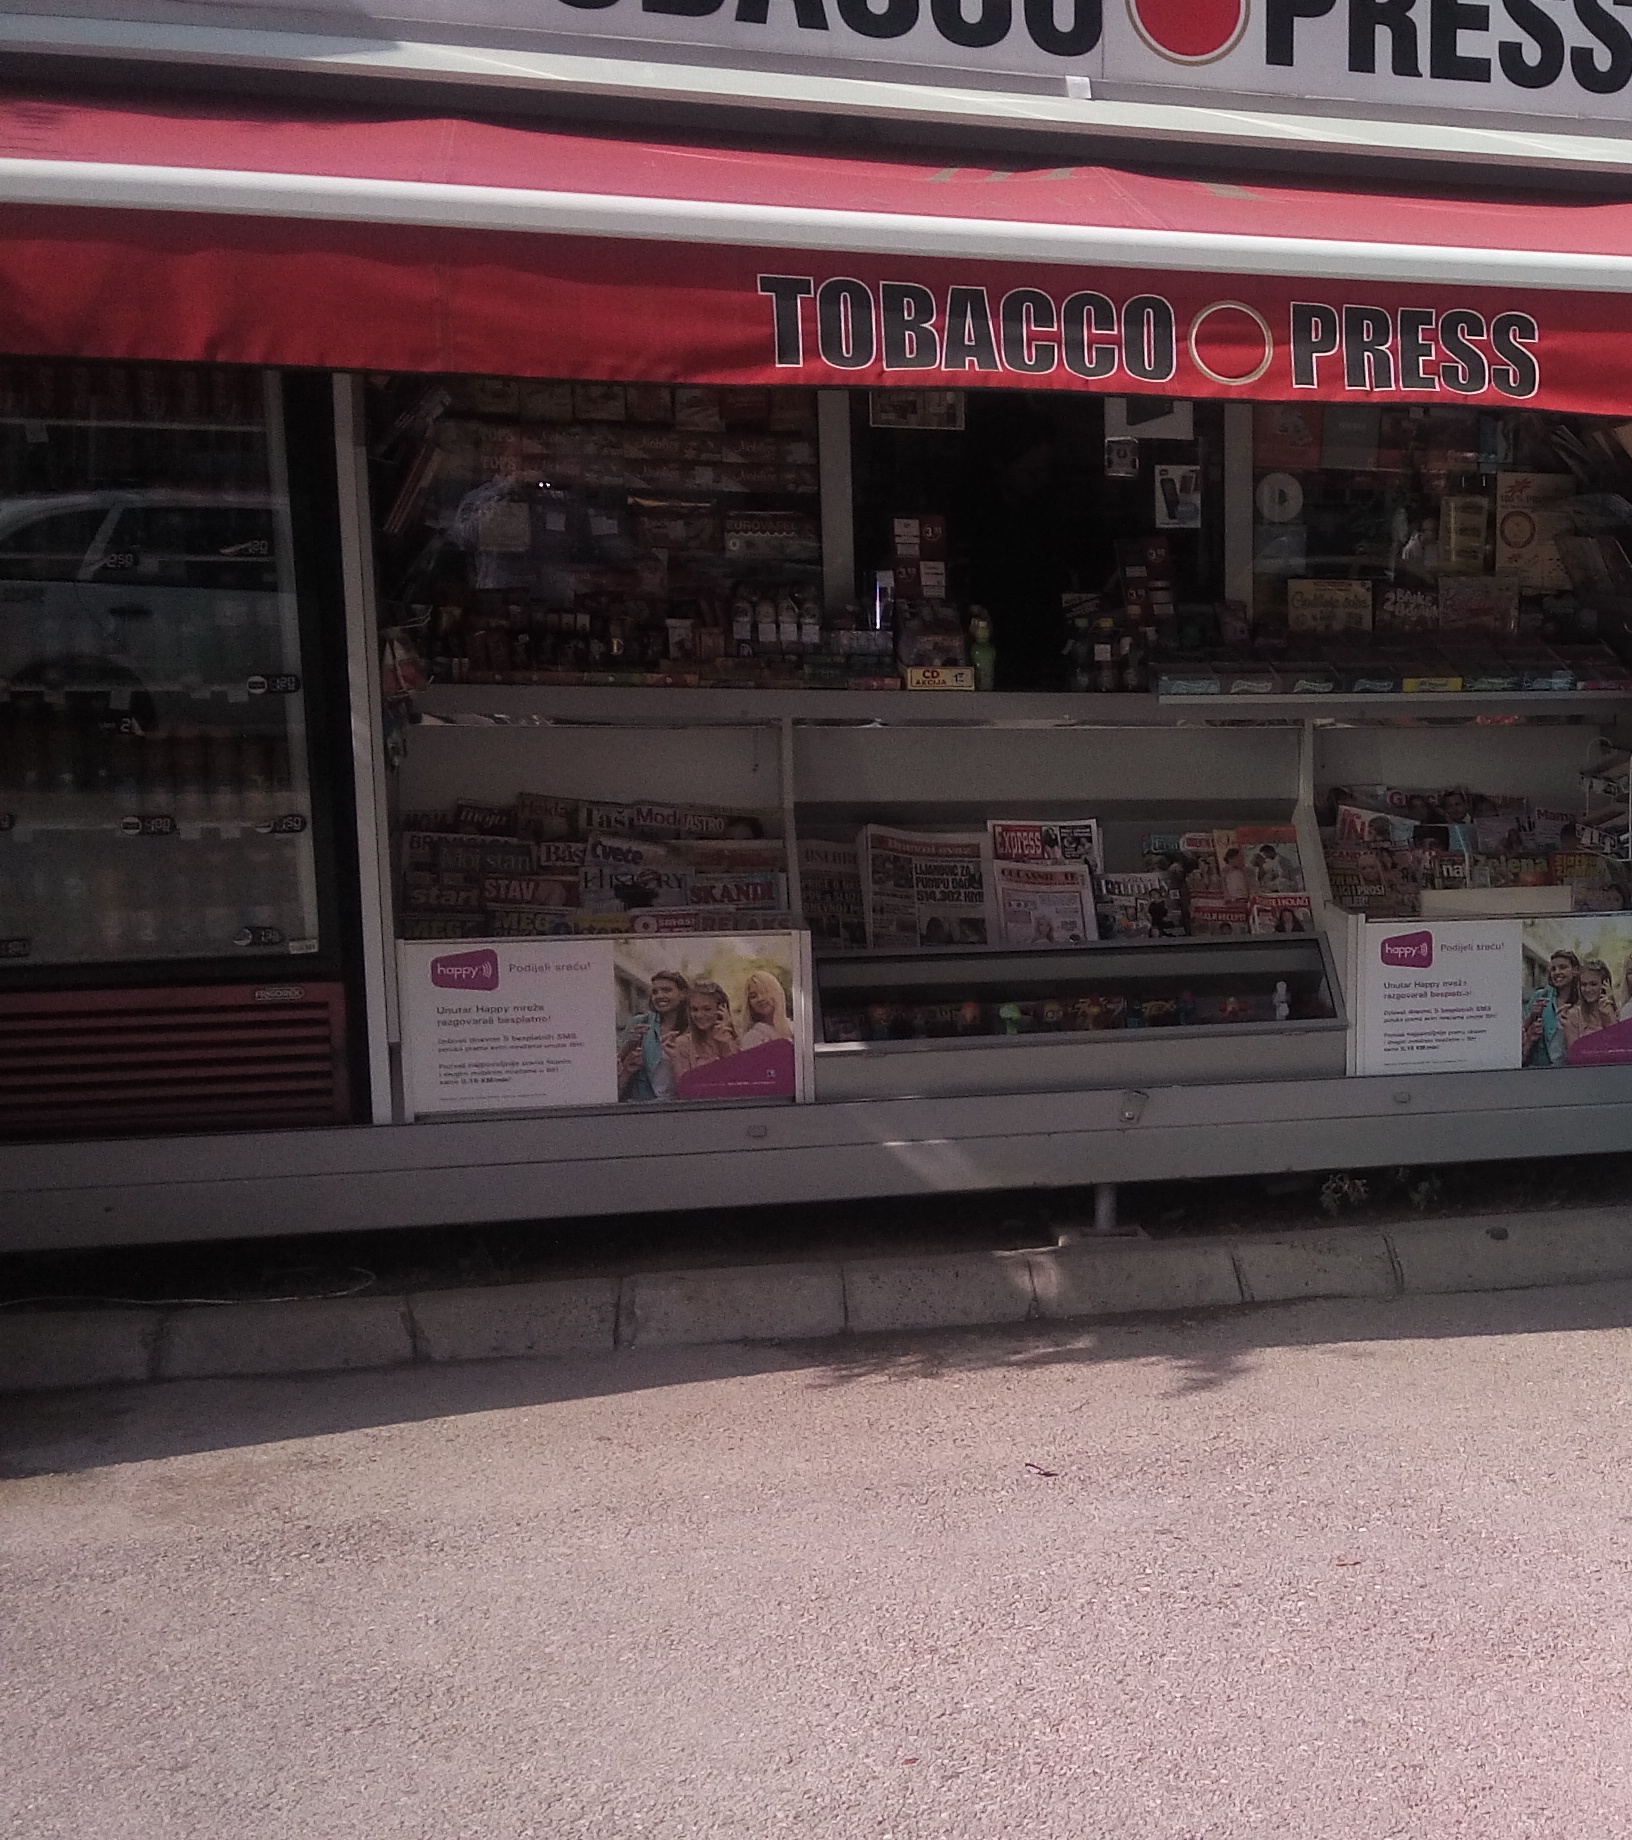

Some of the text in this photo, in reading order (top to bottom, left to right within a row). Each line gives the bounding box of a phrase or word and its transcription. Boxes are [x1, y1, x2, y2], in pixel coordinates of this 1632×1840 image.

[758, 274, 1541, 399] TOBACCO PRESS
[995, 826, 1043, 857] Express
[484, 879, 537, 900] STAV
[1385, 942, 1417, 958] happy
[437, 963, 479, 980] happy
[436, 1005, 473, 1015] Unutar
[475, 1004, 510, 1015] Happy
